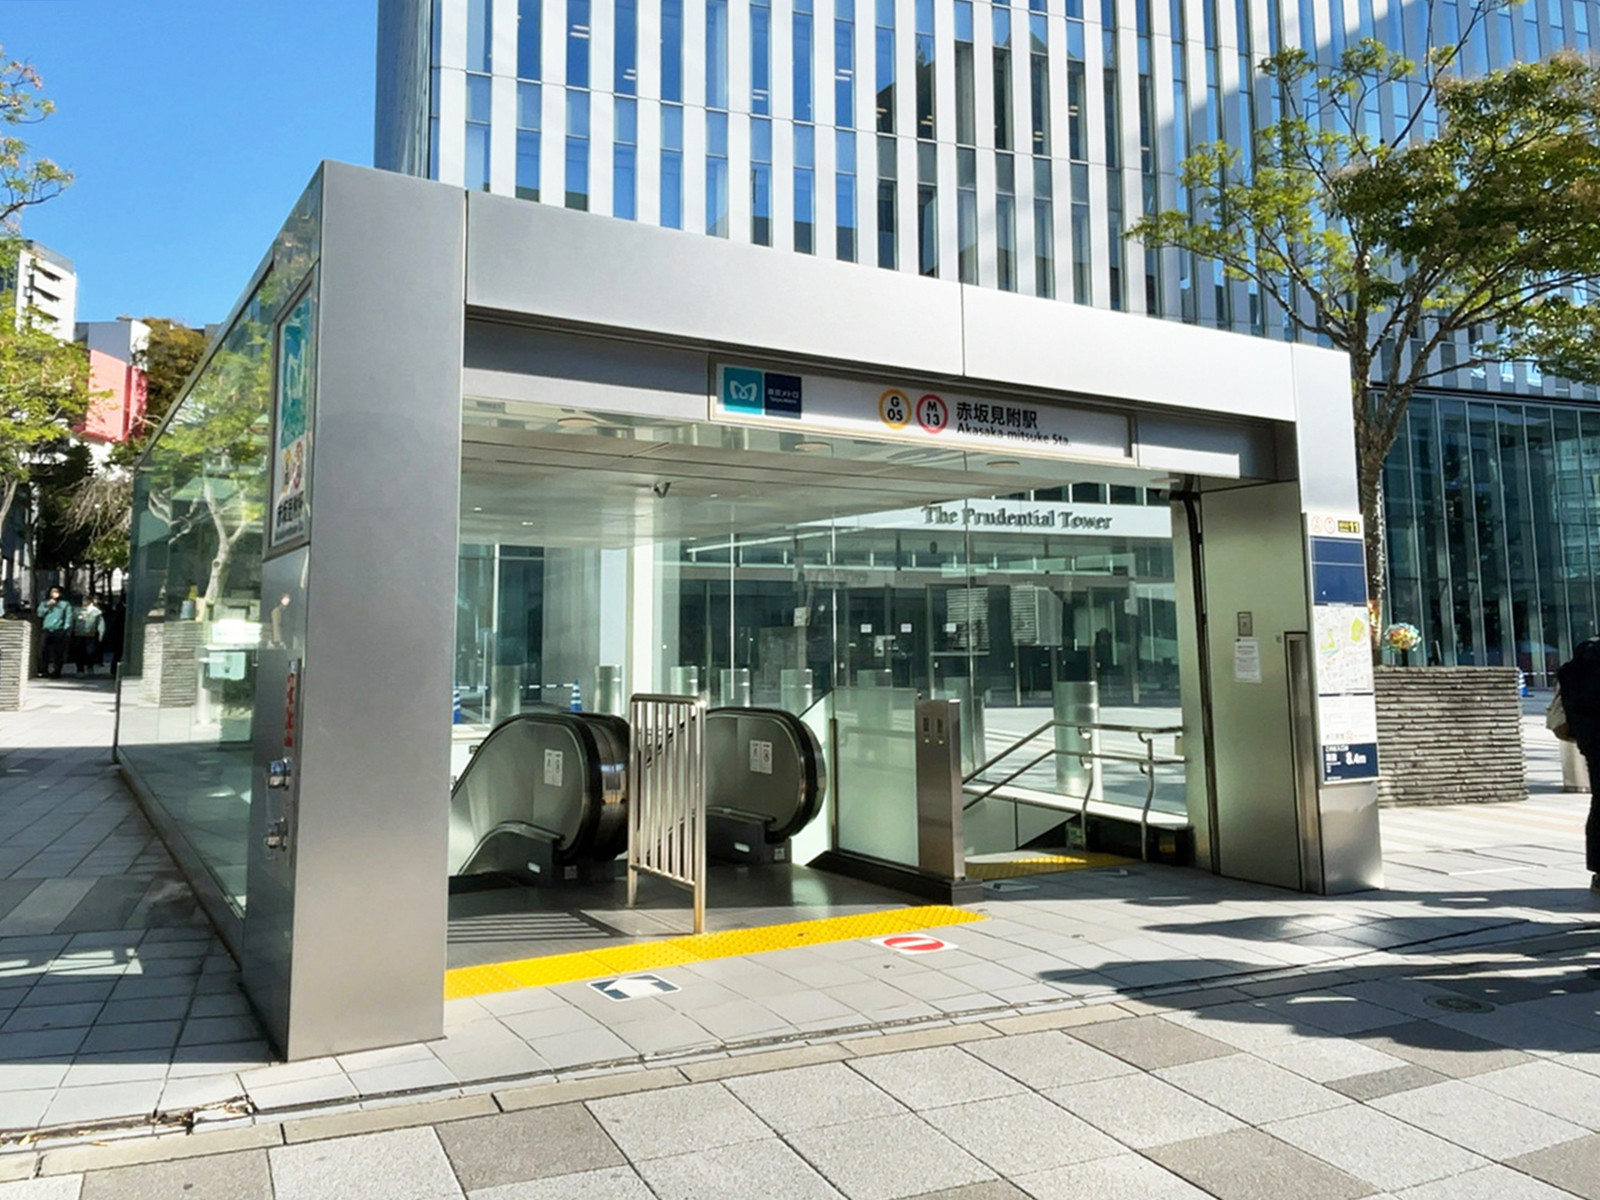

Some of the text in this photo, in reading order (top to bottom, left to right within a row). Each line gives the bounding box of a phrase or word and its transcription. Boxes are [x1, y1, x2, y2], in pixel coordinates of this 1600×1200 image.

[890, 395, 900, 407] G
[927, 401, 938, 412] M
[887, 408, 903, 421] 05
[926, 412, 940, 426] 13
[956, 401, 1038, 429] 赤坂見附駅
[956, 422, 1050, 444] Akasaka-mitsuke
[921, 504, 1113, 530] The Prudential Tower
